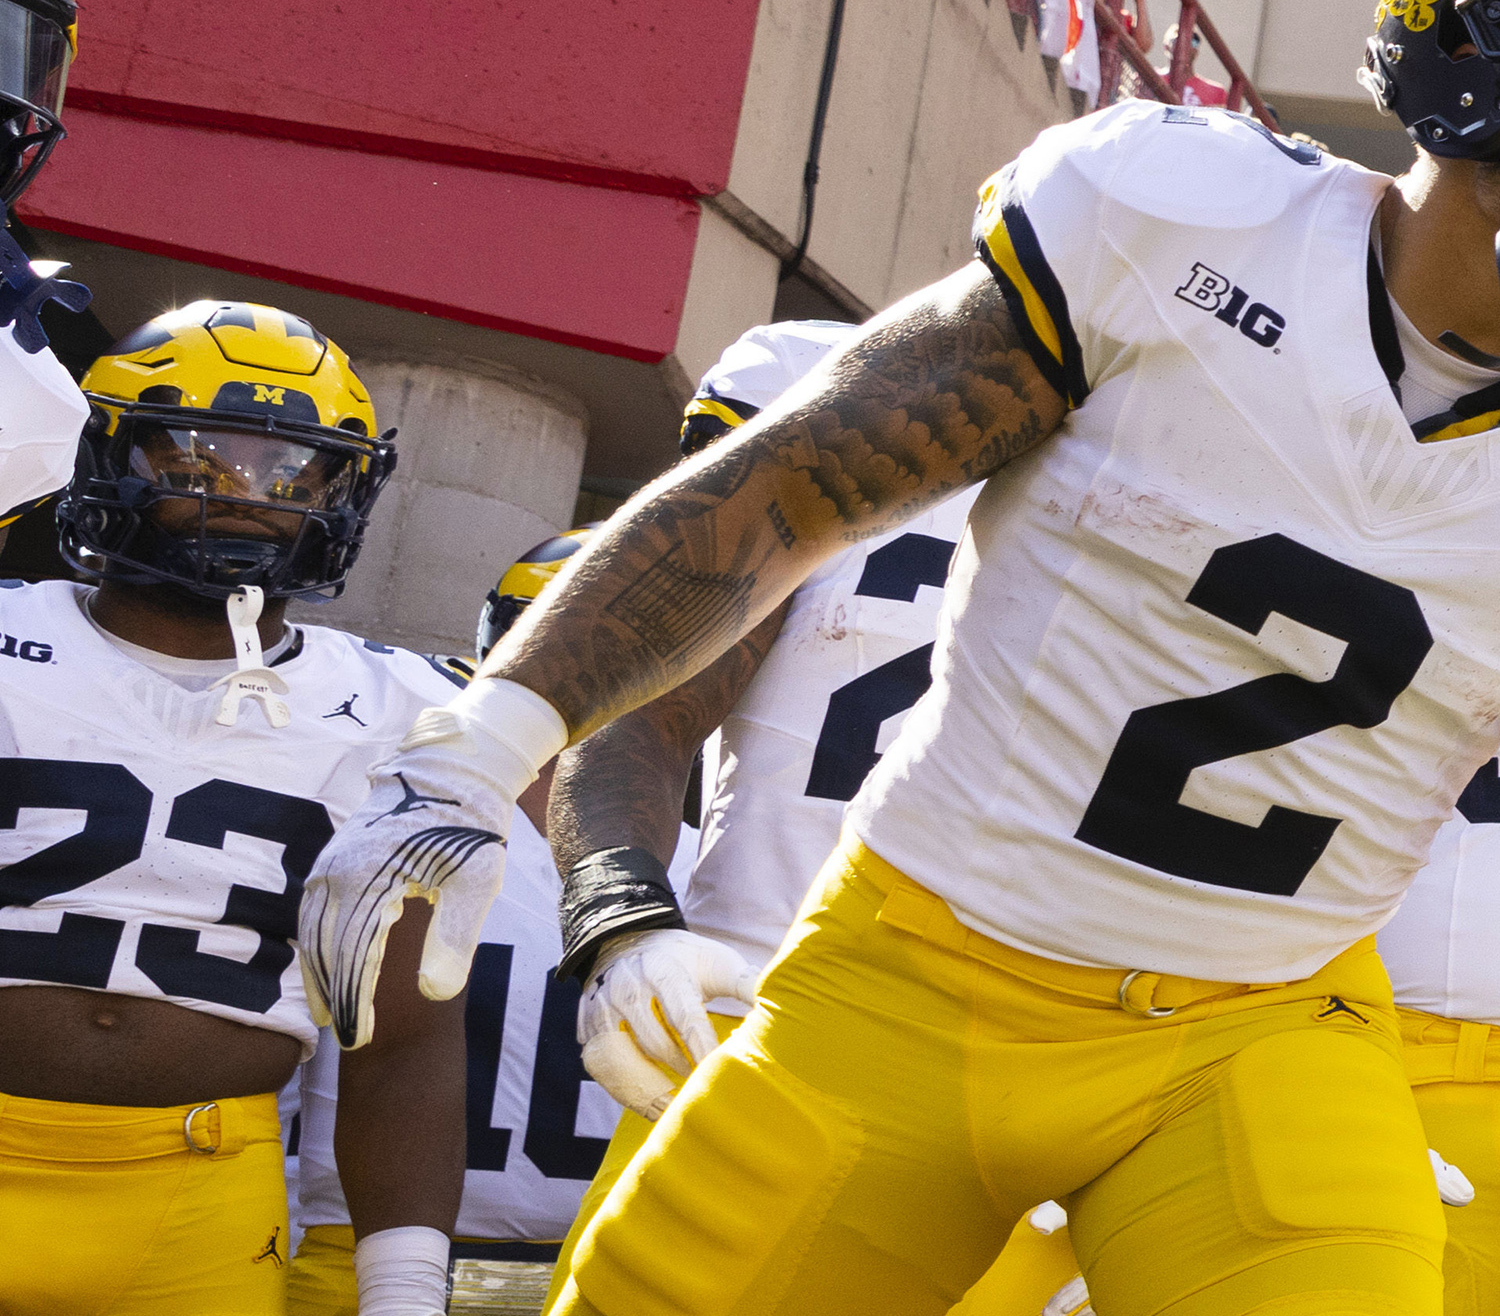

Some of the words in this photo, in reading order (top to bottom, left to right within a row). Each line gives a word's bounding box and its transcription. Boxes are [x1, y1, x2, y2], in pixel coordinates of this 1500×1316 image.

[253, 384, 287, 406] M
[1073, 532, 1434, 897] 2
[0, 757, 335, 1014] 23
